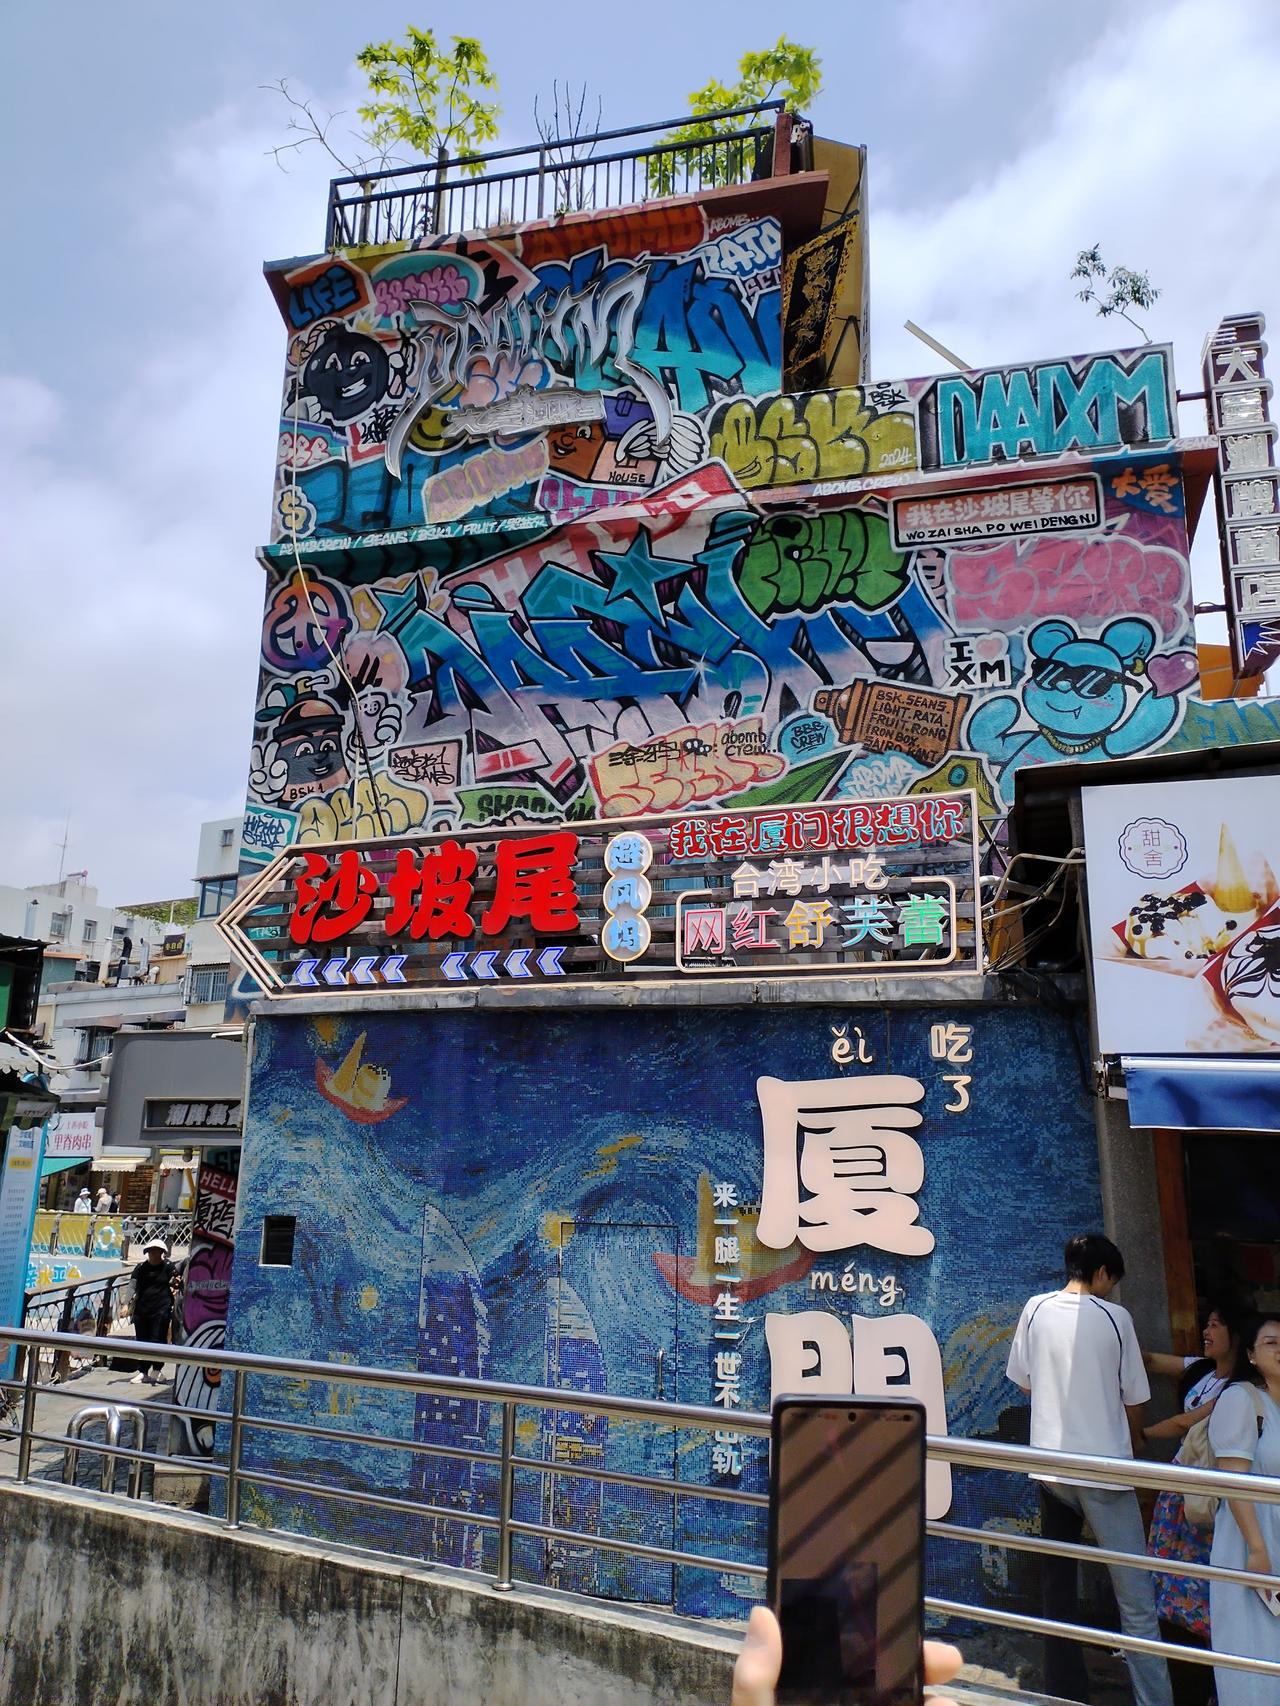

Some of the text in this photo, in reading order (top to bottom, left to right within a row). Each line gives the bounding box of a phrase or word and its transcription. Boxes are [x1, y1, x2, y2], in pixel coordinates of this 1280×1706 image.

[288, 264, 358, 329] LIFE
[609, 471, 646, 483] HOUSE
[906, 485, 1090, 526] 我在沙坡尾等你
[906, 513, 1096, 541] WO ZAI SHA PO WEI DENG NI
[949, 660, 1006, 688] XM
[721, 729, 768, 745] abomb
[791, 727, 828, 750] CREW
[792, 722, 824, 737] BBB
[866, 724, 895, 738] IRON
[289, 782, 326, 800] BSK1
[669, 798, 965, 860] 我在厦门很想你
[1142, 829, 1162, 867] 甜舍
[289, 831, 581, 945] 沙坡尾
[731, 853, 891, 900] 台湾小吃
[683, 892, 950, 955] 网红舒芙蕾
[811, 1261, 898, 1307] méng
